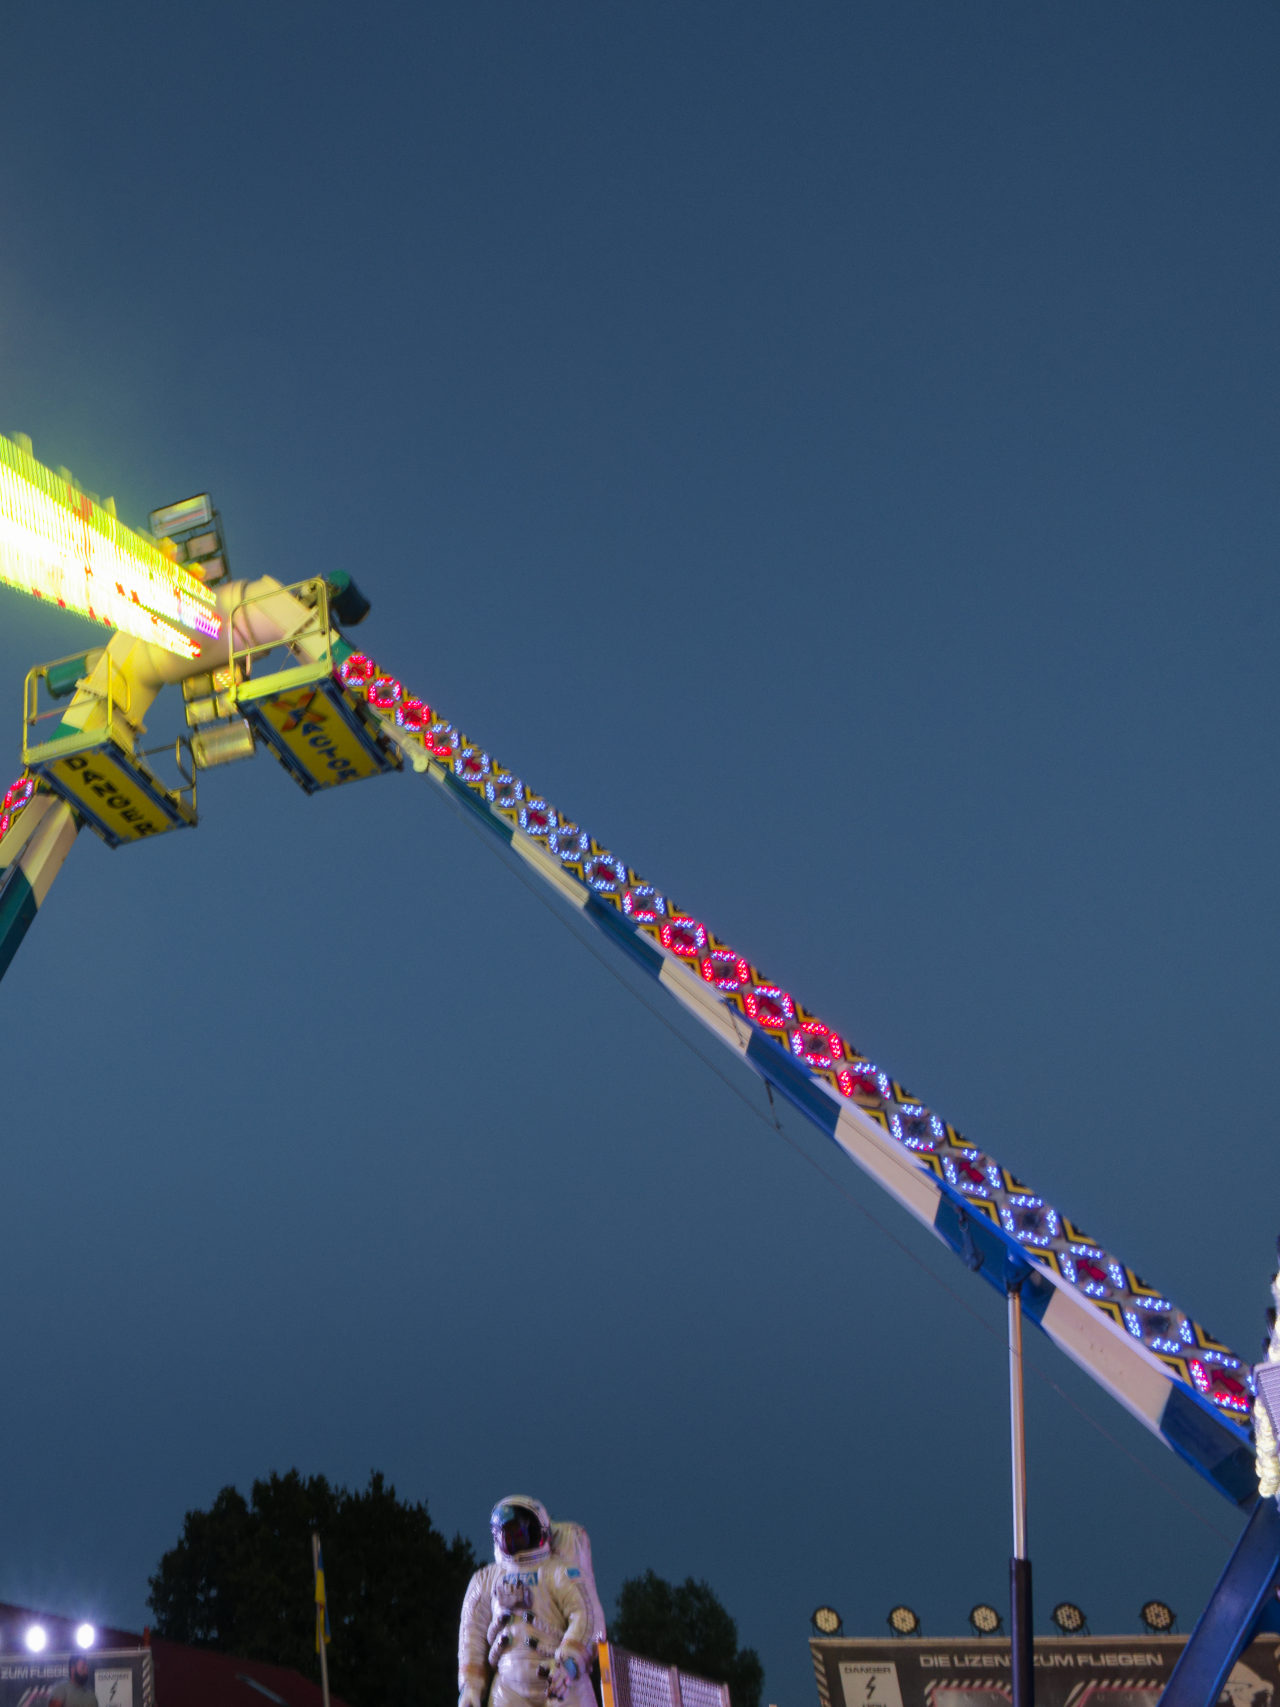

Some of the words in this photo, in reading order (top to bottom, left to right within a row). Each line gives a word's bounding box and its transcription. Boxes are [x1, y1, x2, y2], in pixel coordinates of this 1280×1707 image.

[920, 1654, 951, 1668] DIE
[953, 1654, 1012, 1667] LIZEN
[1076, 1652, 1164, 1667] FLIEGEN
[30, 1664, 70, 1678] FLIEGE
